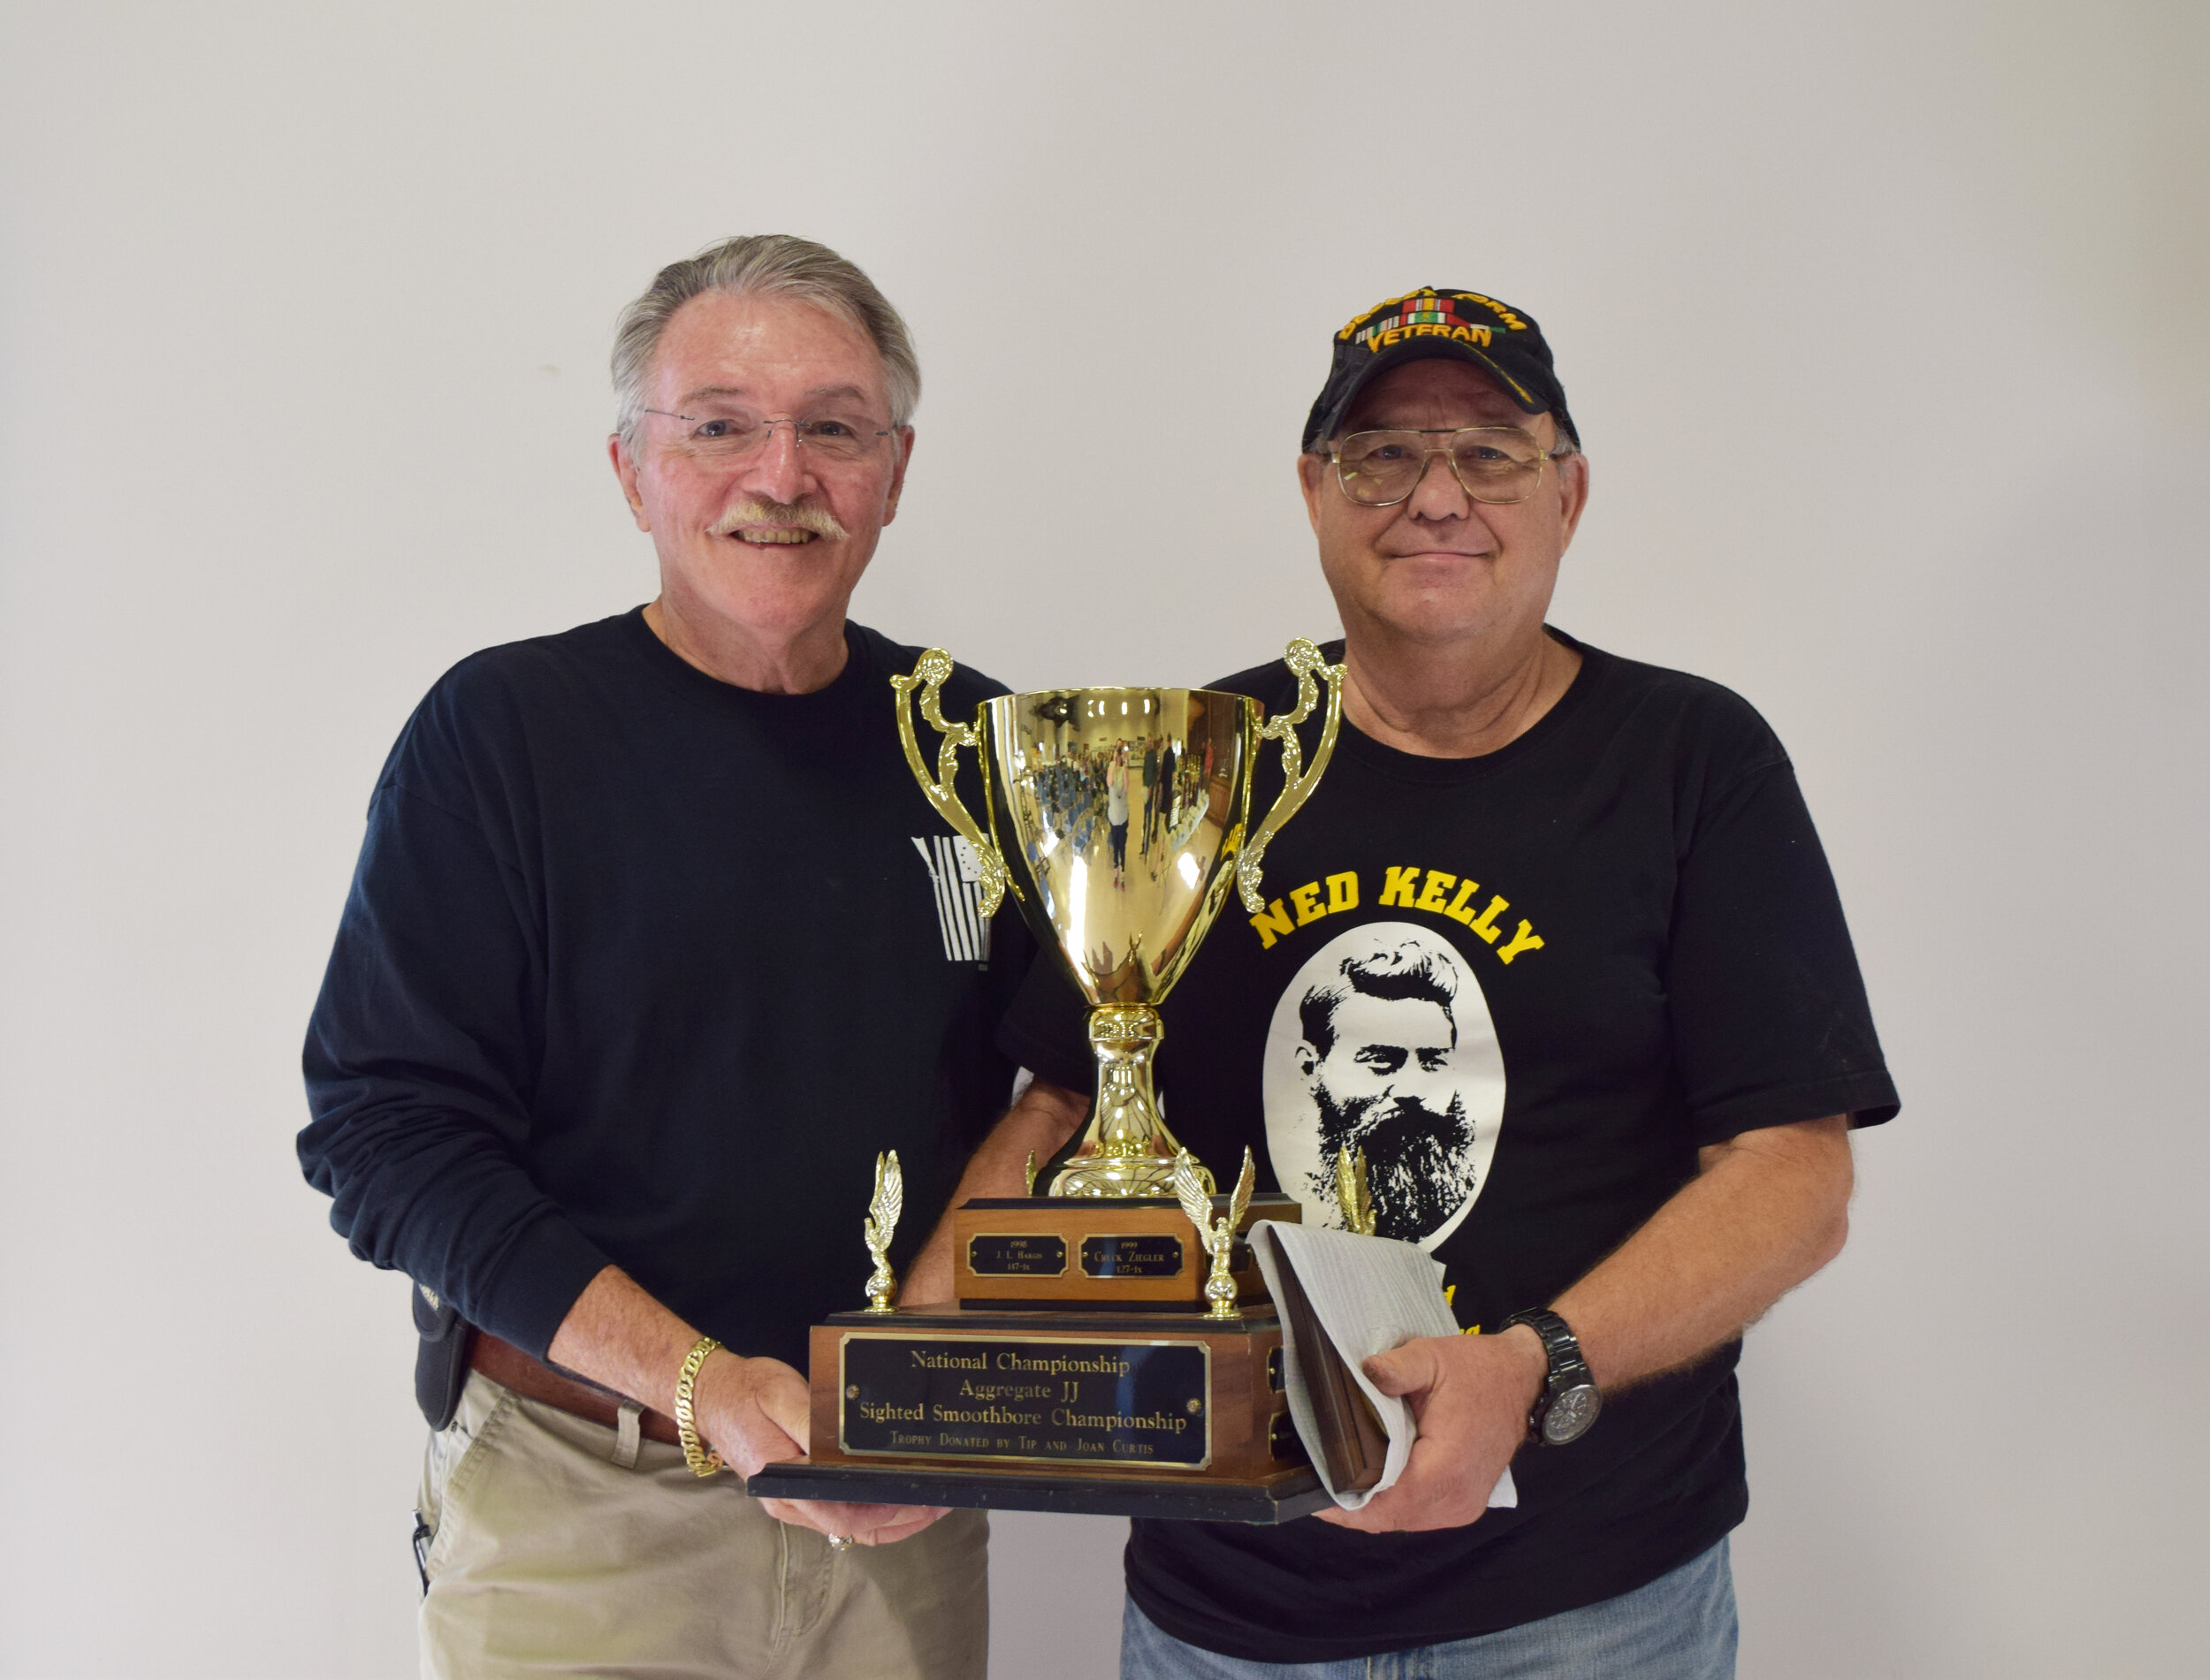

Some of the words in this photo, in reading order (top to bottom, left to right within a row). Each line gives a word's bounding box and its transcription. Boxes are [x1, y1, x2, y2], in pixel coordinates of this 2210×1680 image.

[1368, 323, 1492, 353] VETERAN
[1249, 870, 1359, 950] NED
[1378, 866, 1545, 965] KELLY
[1128, 1250, 1165, 1262] ZIEGLER
[911, 1350, 987, 1370] National
[996, 1352, 1131, 1377] Championship
[959, 1379, 1052, 1402] Aggregate
[1061, 1381, 1079, 1403] JJ
[859, 1402, 925, 1424] Sighted
[933, 1403, 1042, 1425] Smoothbore
[1051, 1408, 1186, 1434] Championship
[890, 1430, 932, 1445] TROPHY
[940, 1433, 989, 1448] DONATED
[1018, 1435, 1037, 1449] TIP
[1075, 1438, 1105, 1452] JOAN
[1112, 1440, 1155, 1454] CURTIS
